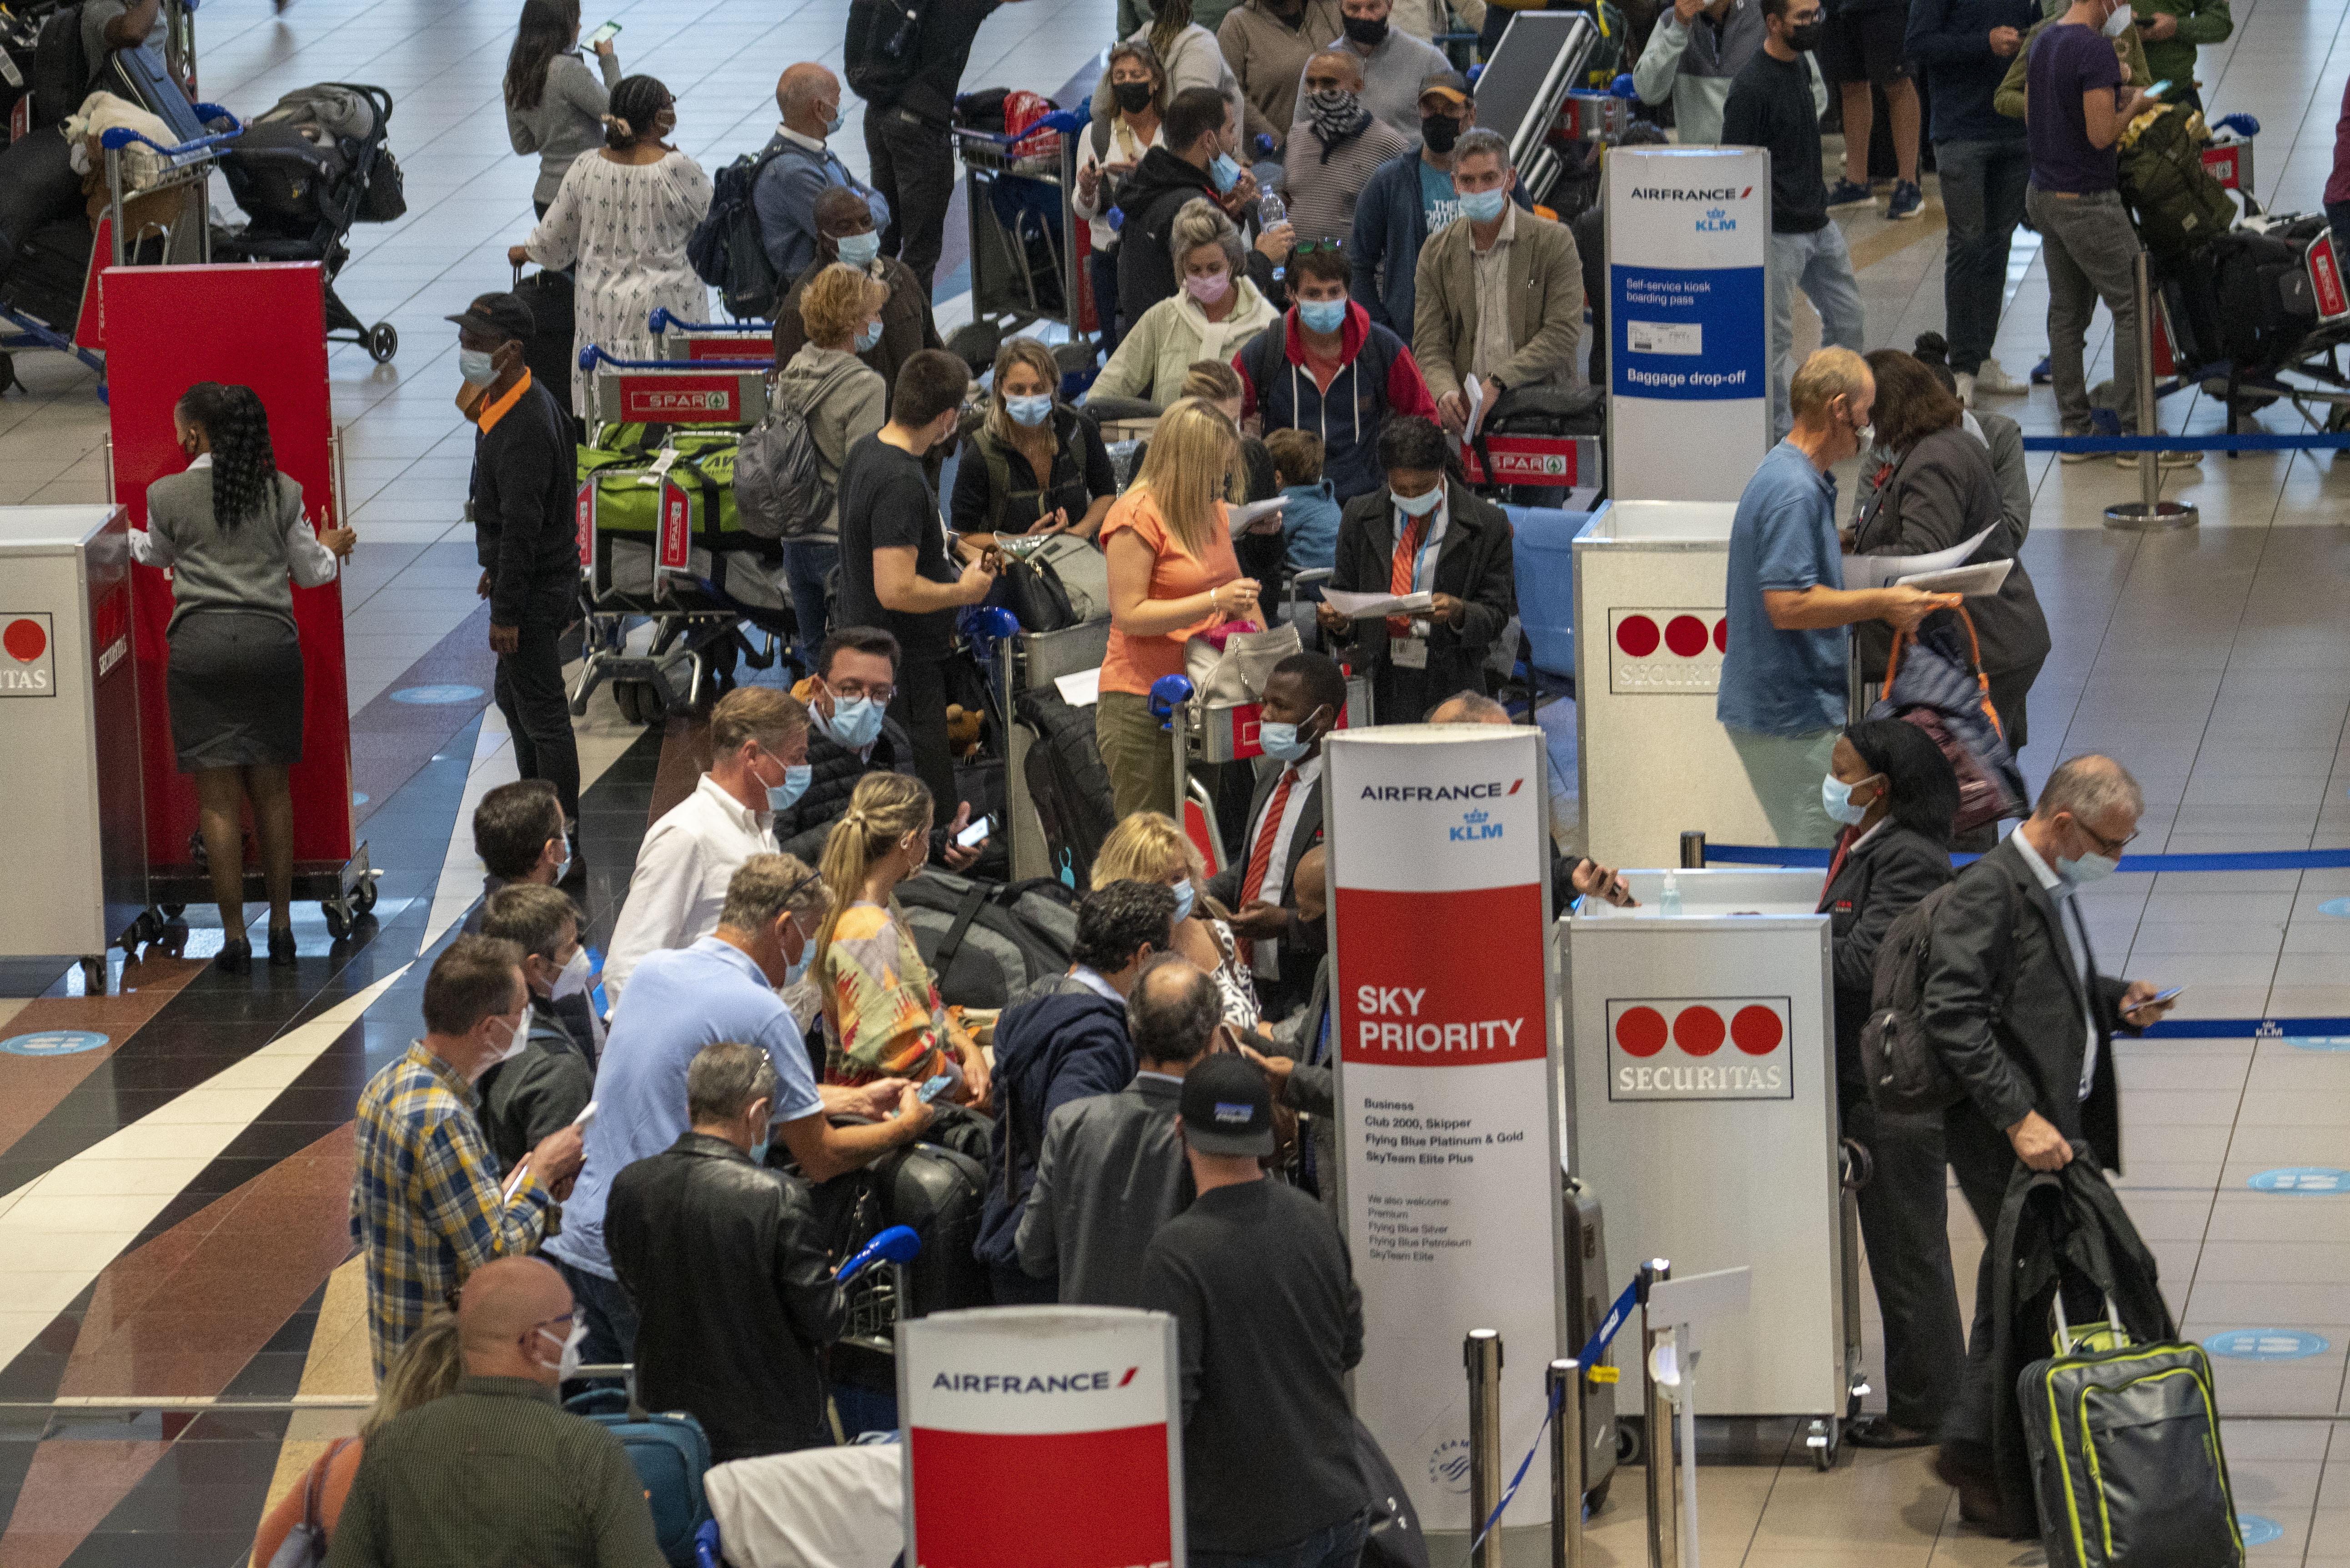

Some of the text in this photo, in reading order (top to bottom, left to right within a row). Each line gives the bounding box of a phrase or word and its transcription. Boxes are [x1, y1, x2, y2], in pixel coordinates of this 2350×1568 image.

[1631, 187, 1736, 201] AIRFRANCE
[1425, 210, 1458, 223] ORTH
[1695, 219, 1736, 232] KLM
[1627, 278, 1711, 293] Self-service kiosk
[1627, 291, 1694, 307] boarding pass
[1627, 367, 1746, 387] Baggage drop-off
[649, 394, 705, 408] SPAR
[670, 517, 681, 550] SPAR
[1361, 782, 1501, 802] AIRFRANCE
[1449, 823, 1503, 841] KLM
[1358, 985, 1426, 1016] SKY
[1359, 1017, 1525, 1053] PRIORITY
[2255, 1027, 2283, 1037] KLM
[1619, 1065, 1782, 1091] SECURITAS
[1365, 1098, 1414, 1111] Business
[1365, 1116, 1472, 1131] Club 2000, Skipper
[1365, 1131, 1524, 1147] Flying Blue Platinum & Gold
[1366, 1150, 1474, 1165] SkyTeam Elite Plus
[1367, 1194, 1381, 1204] We
[1384, 1195, 1403, 1206] also
[1367, 1207, 1409, 1219] Premium
[1368, 1221, 1449, 1234] Flying Blue Silver
[1369, 1235, 1472, 1248] Flying Blue Petroleum
[1370, 1248, 1435, 1262] SkyTeam Elite
[932, 1370, 1110, 1394] AIRFRANCE
